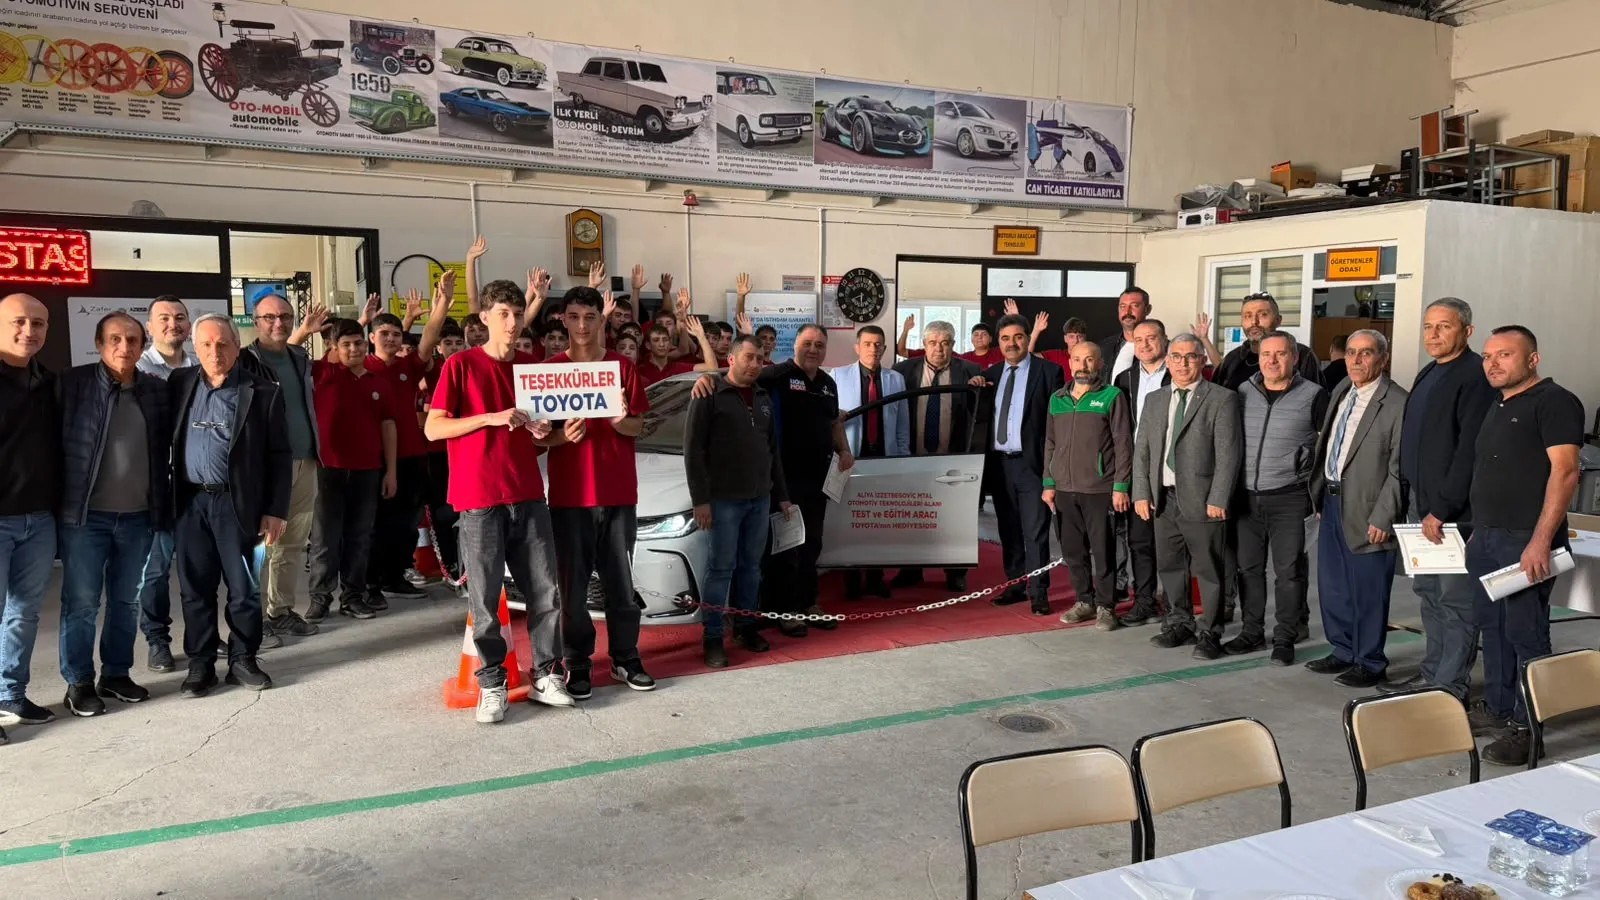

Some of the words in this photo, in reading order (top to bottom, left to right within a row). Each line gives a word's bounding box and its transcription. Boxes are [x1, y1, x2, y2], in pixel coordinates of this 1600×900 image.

[94, 3, 158, 20] SERÜVENİ
[351, 73, 390, 93] 1950
[229, 101, 302, 116] OTO-MOBİL
[556, 108, 572, 117] İLK
[574, 109, 598, 120] YERLİ
[232, 114, 299, 126] automobile
[612, 124, 645, 136] DEVRİM
[1027, 184, 1042, 194] CAN
[1044, 182, 1072, 196] TİCARET
[1074, 186, 1120, 198] KATKILARIYLA
[132, 248, 141, 258] 1
[1330, 257, 1373, 265] ÖĞRETMENLER
[520, 368, 615, 392] TEŞEKKÜRLER
[530, 392, 608, 414] TOYOTA
[852, 510, 871, 518] TEST
[884, 508, 911, 518] EĞİTİM
